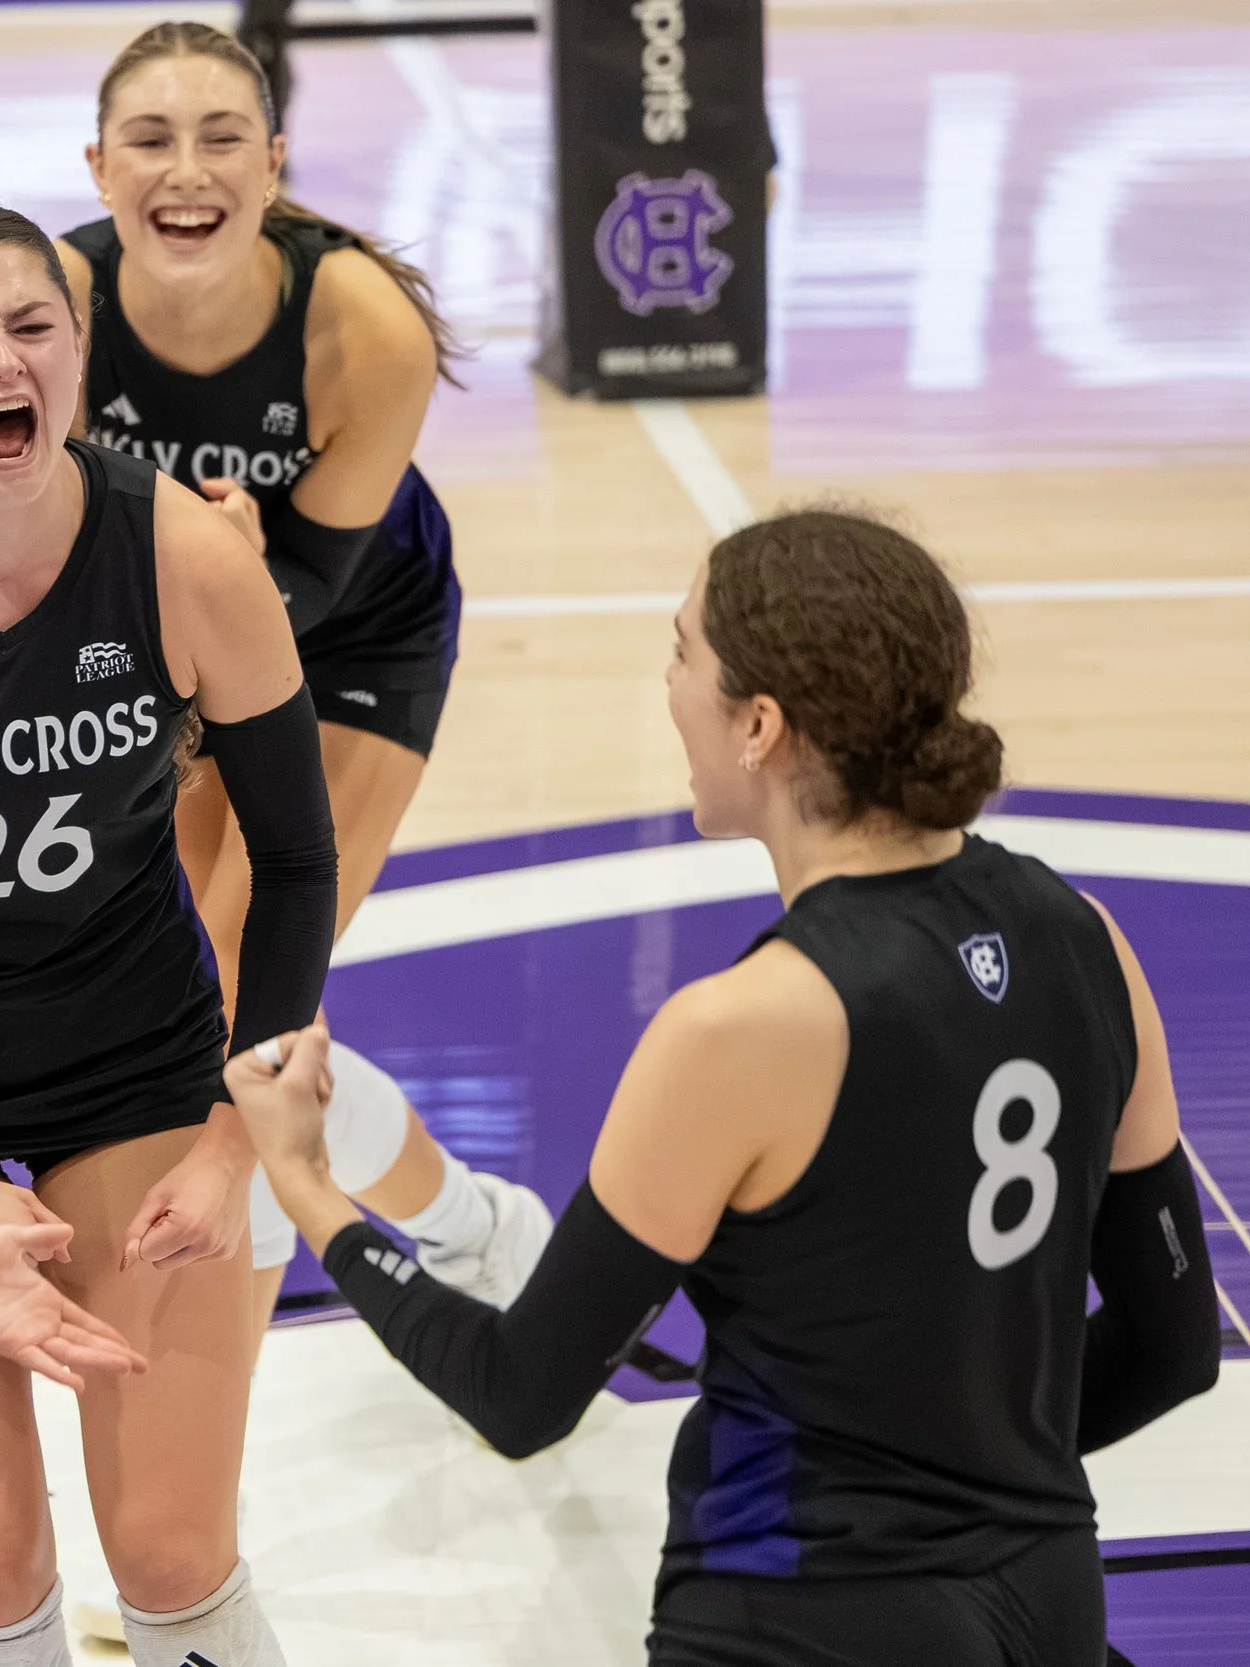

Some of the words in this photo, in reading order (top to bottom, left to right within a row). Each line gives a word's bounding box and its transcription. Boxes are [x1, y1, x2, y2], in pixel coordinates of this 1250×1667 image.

[75, 653, 134, 675] PATRIOT
[76, 662, 135, 683] LEAGUE
[1, 694, 158, 776] CROSS
[967, 1057, 1061, 1271] 8
